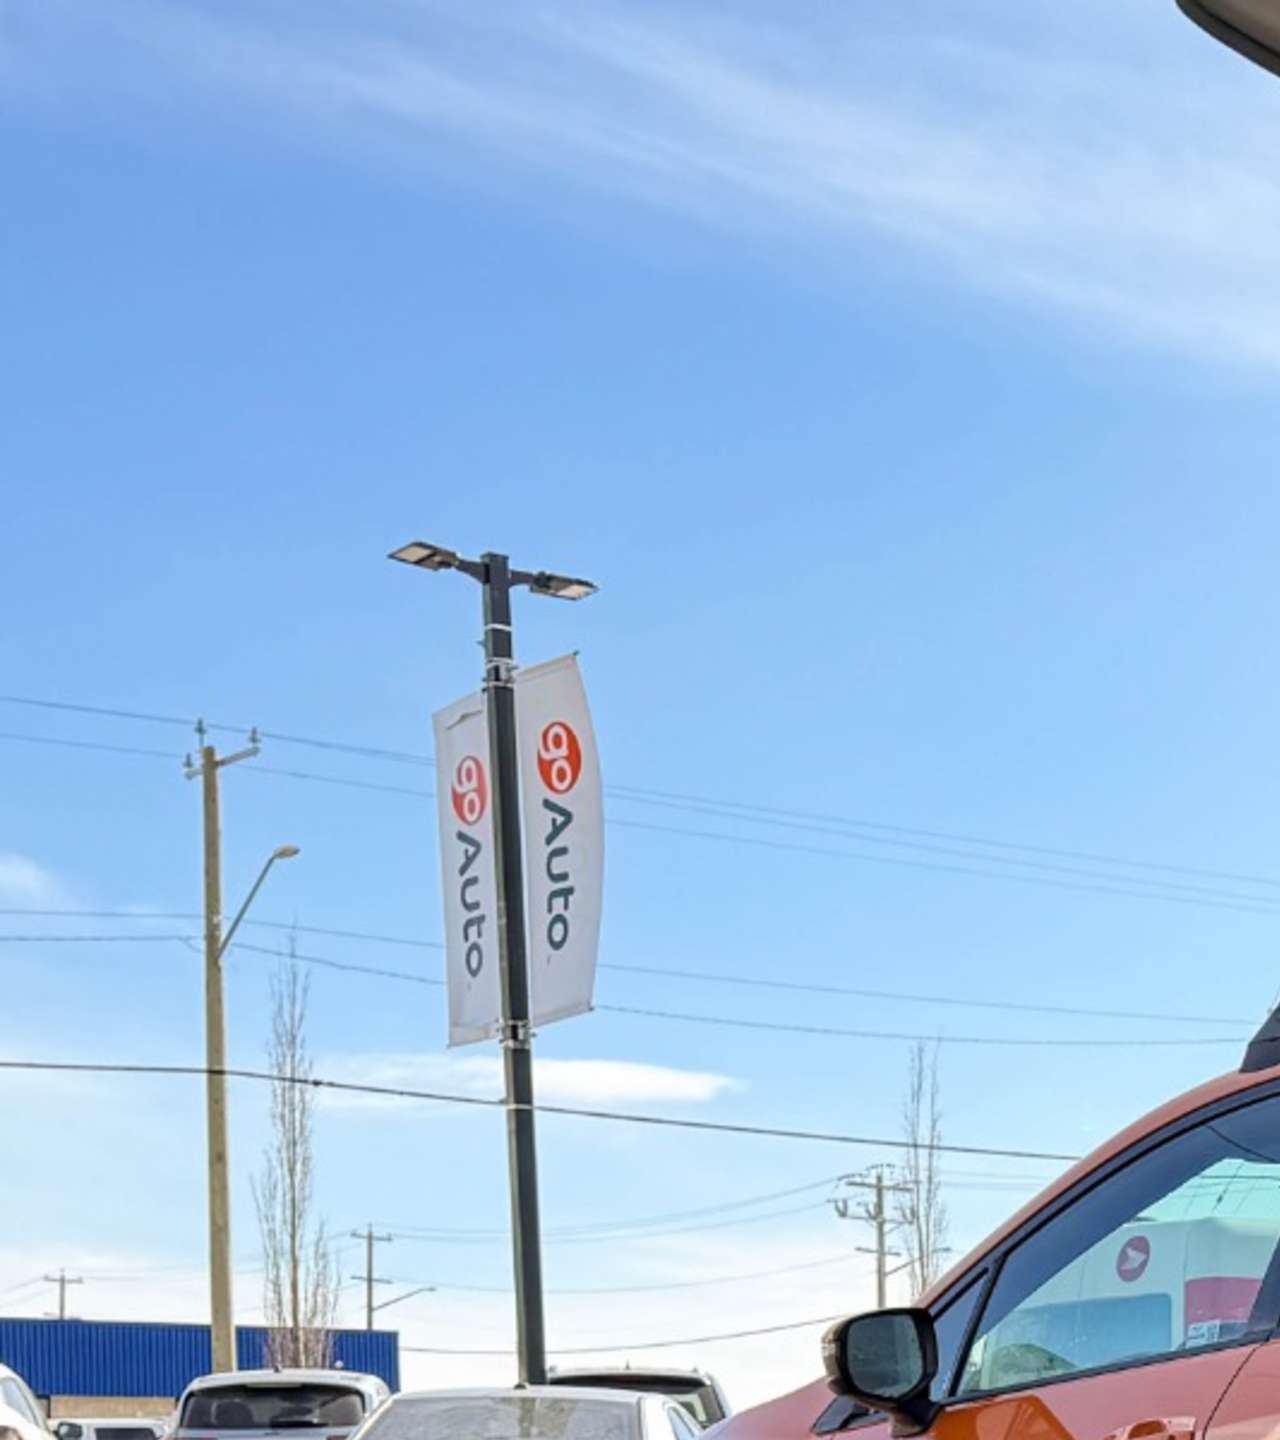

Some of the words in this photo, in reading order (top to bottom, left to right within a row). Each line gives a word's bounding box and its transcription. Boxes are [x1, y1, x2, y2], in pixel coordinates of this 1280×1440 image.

[453, 756, 481, 823] go
[539, 723, 573, 791] go
[456, 830, 486, 978] Auto
[542, 798, 575, 951] Auto
